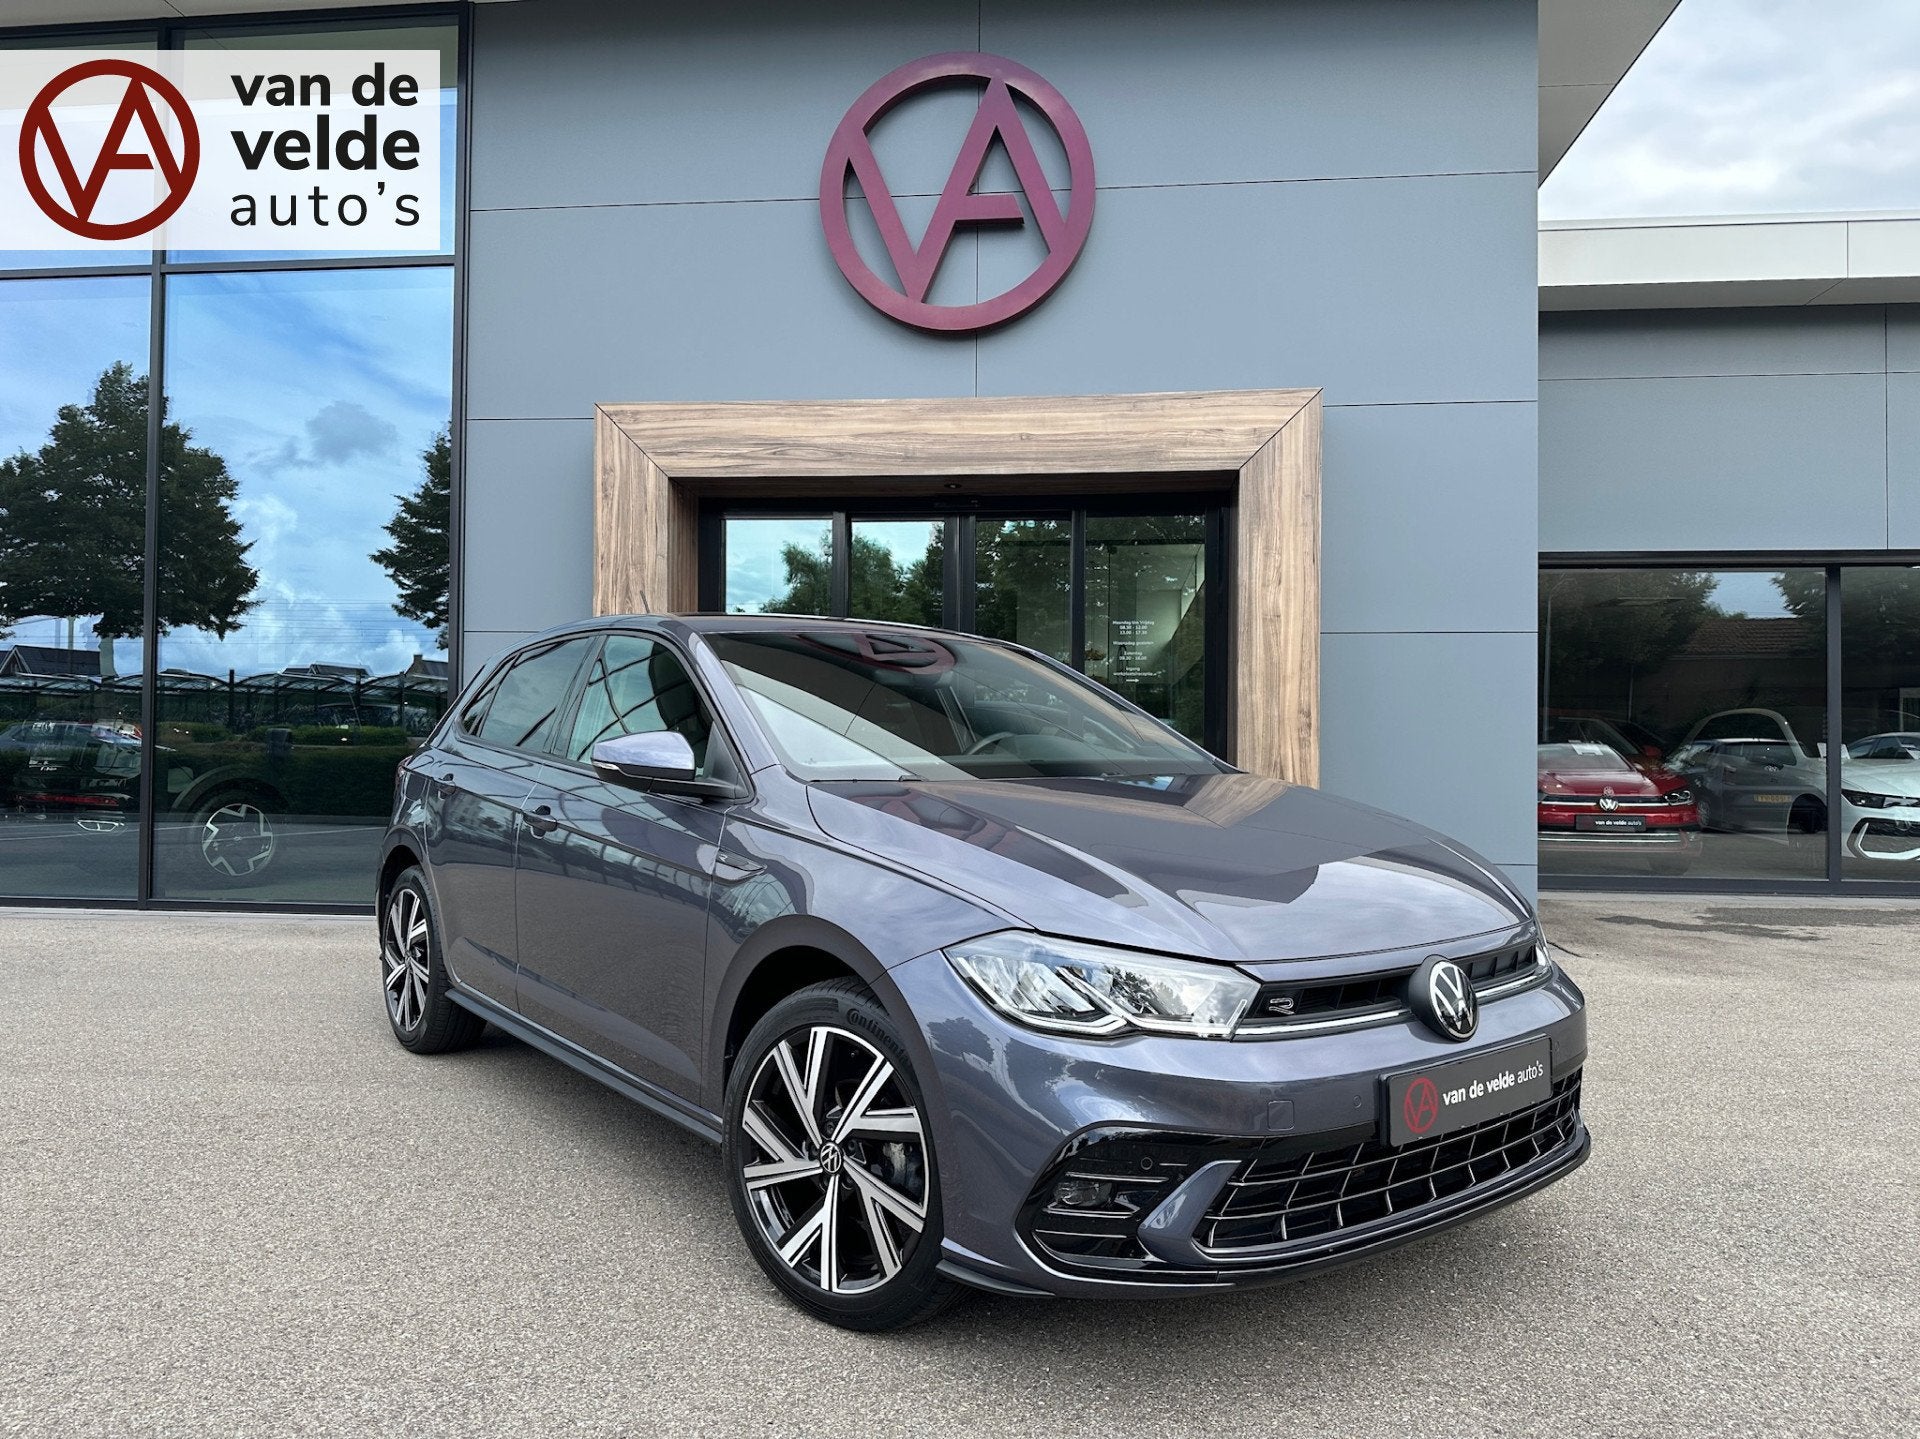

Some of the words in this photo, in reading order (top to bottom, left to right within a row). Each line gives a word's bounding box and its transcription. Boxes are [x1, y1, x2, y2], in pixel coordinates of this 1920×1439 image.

[1442, 1087, 1467, 1106] van
[1469, 1080, 1485, 1099] de
[1486, 1070, 1515, 1094] velde
[1517, 1060, 1544, 1084] auto's
